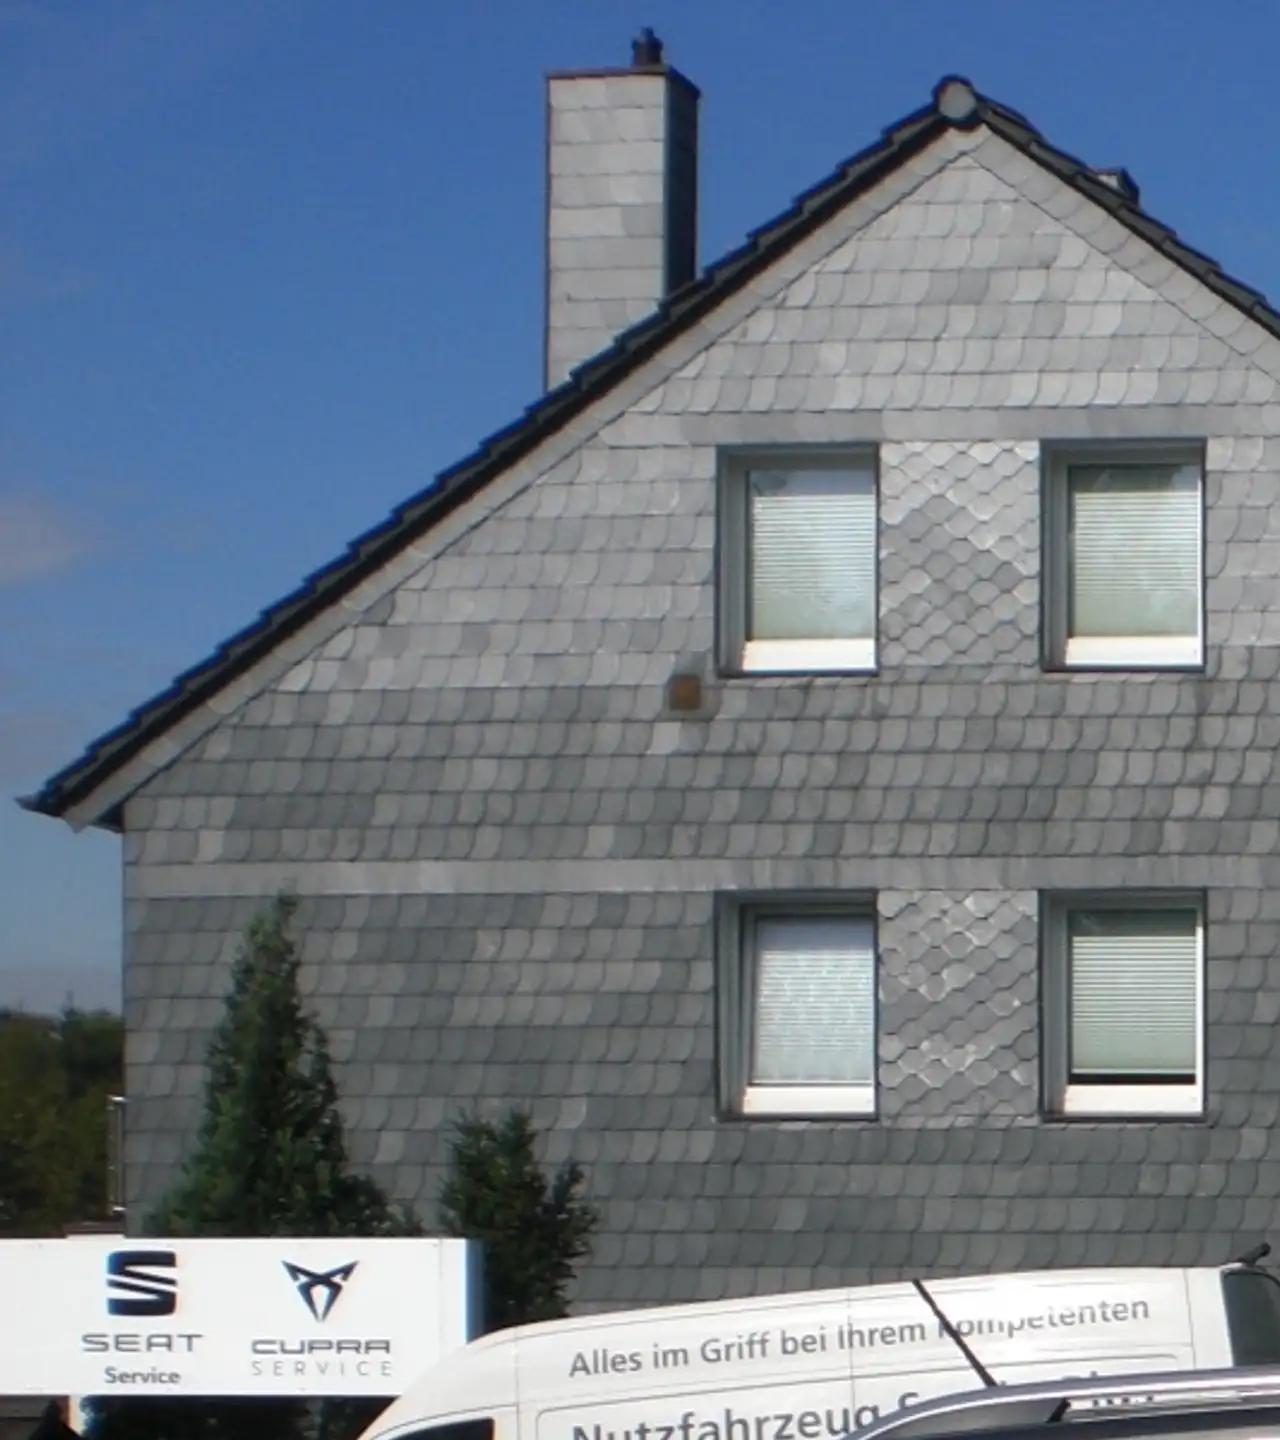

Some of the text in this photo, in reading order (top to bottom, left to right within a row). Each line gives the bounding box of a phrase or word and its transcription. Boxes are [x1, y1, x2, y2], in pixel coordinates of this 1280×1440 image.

[82, 1333, 205, 1353] SEAT
[251, 1339, 392, 1355] CUPRA
[569, 1348, 643, 1378] Alles
[652, 1343, 690, 1370] im
[700, 1329, 770, 1364] Griff
[780, 1324, 827, 1355] bei
[838, 1321, 926, 1350] Ihrem
[104, 1366, 182, 1385] Service
[251, 1360, 393, 1377] SERVICE
